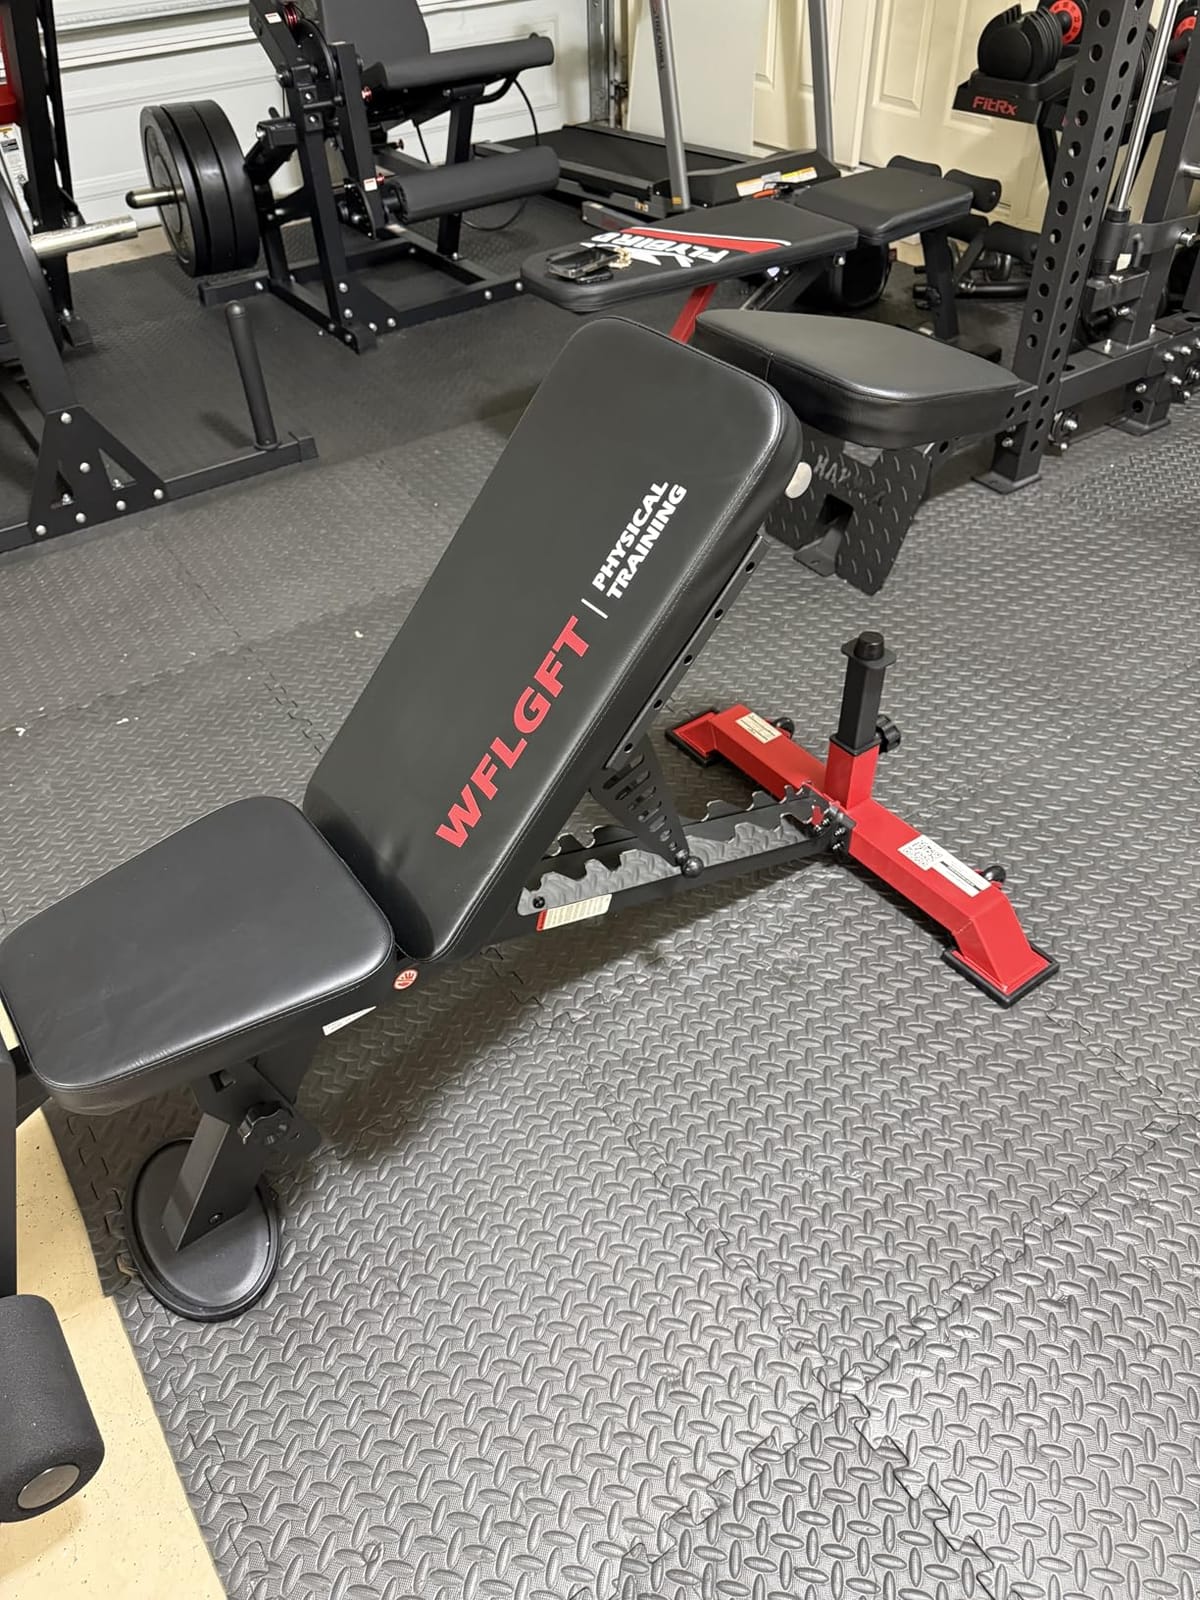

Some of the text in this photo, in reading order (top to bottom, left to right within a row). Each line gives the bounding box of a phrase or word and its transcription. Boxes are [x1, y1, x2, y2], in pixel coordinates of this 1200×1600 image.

[972, 95, 1018, 116] FitRx
[591, 232, 730, 263] FLYBIRD
[591, 481, 669, 591] PHYSICAL
[606, 484, 687, 600] TRAINING
[435, 615, 589, 848] WFLGFT
